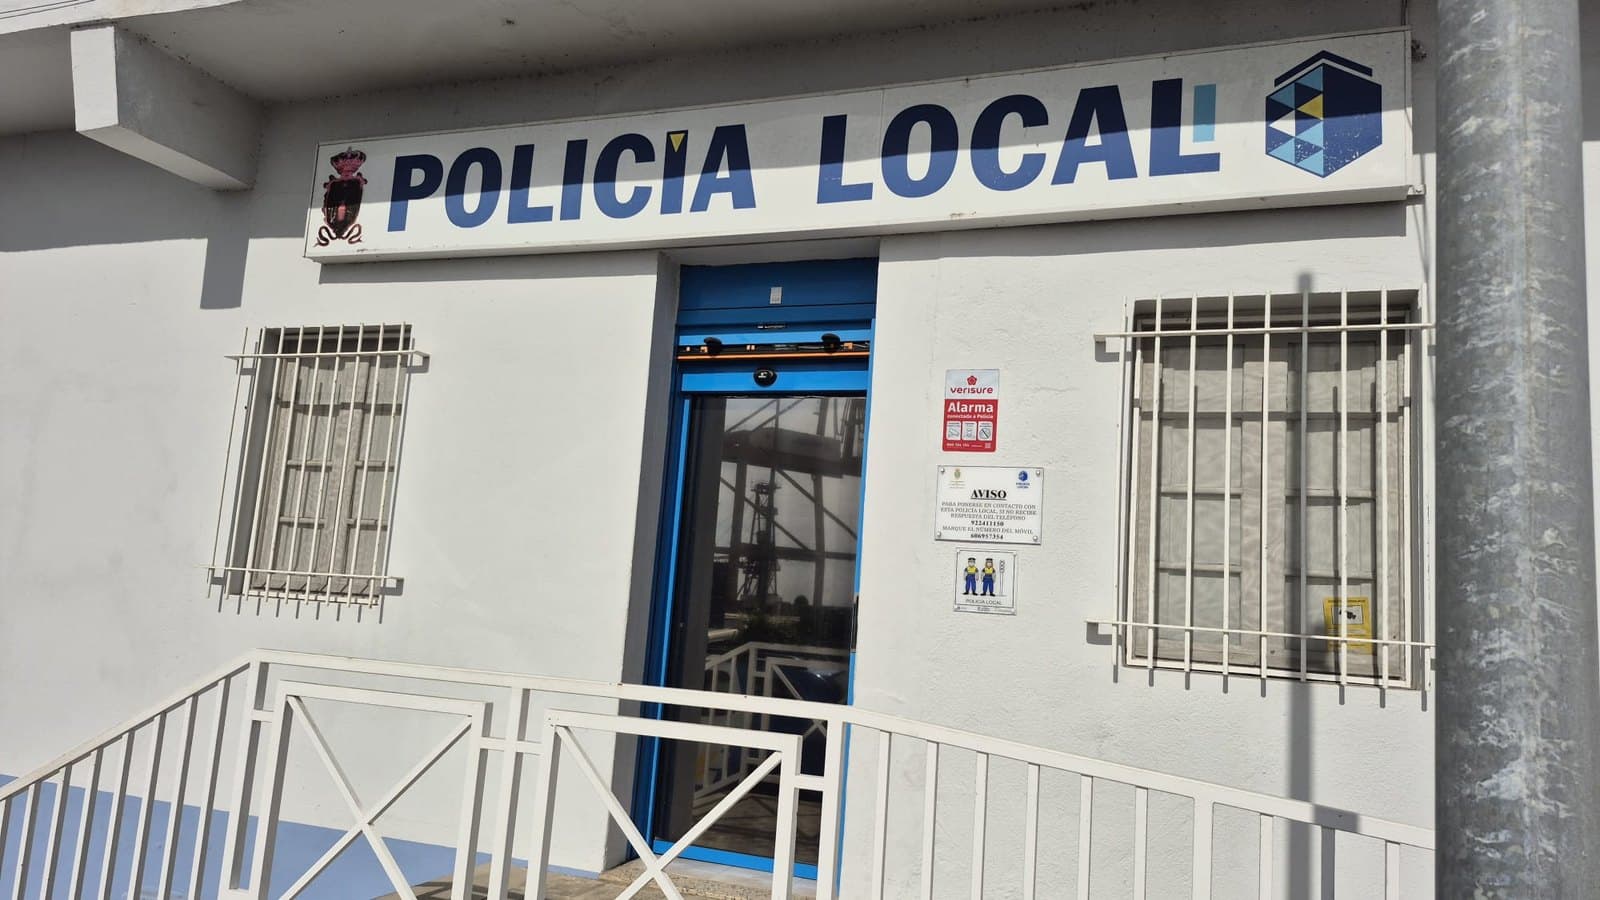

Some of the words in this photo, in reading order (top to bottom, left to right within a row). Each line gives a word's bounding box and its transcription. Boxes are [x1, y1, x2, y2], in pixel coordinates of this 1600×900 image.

[816, 78, 1221, 204] LOCAL
[948, 401, 994, 413] Alarma
[970, 489, 1007, 499] AVISO
